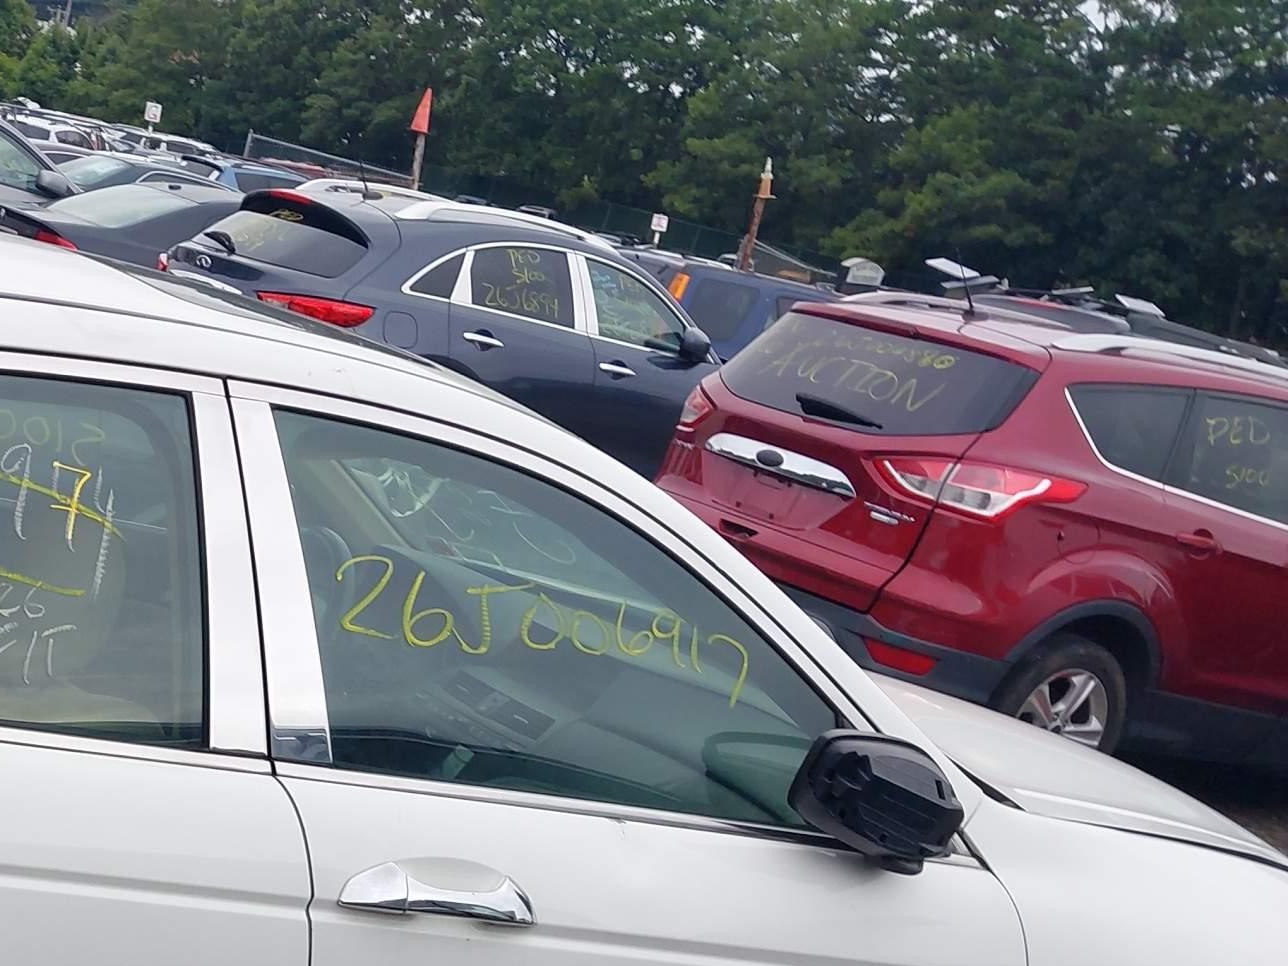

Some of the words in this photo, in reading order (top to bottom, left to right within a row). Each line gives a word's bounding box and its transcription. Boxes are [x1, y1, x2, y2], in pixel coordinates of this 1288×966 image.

[508, 248, 541, 269] PED
[760, 348, 946, 412] AUCTION
[1205, 416, 1272, 447] PED
[1224, 465, 1271, 490] S100
[334, 553, 750, 709] 26J006917
